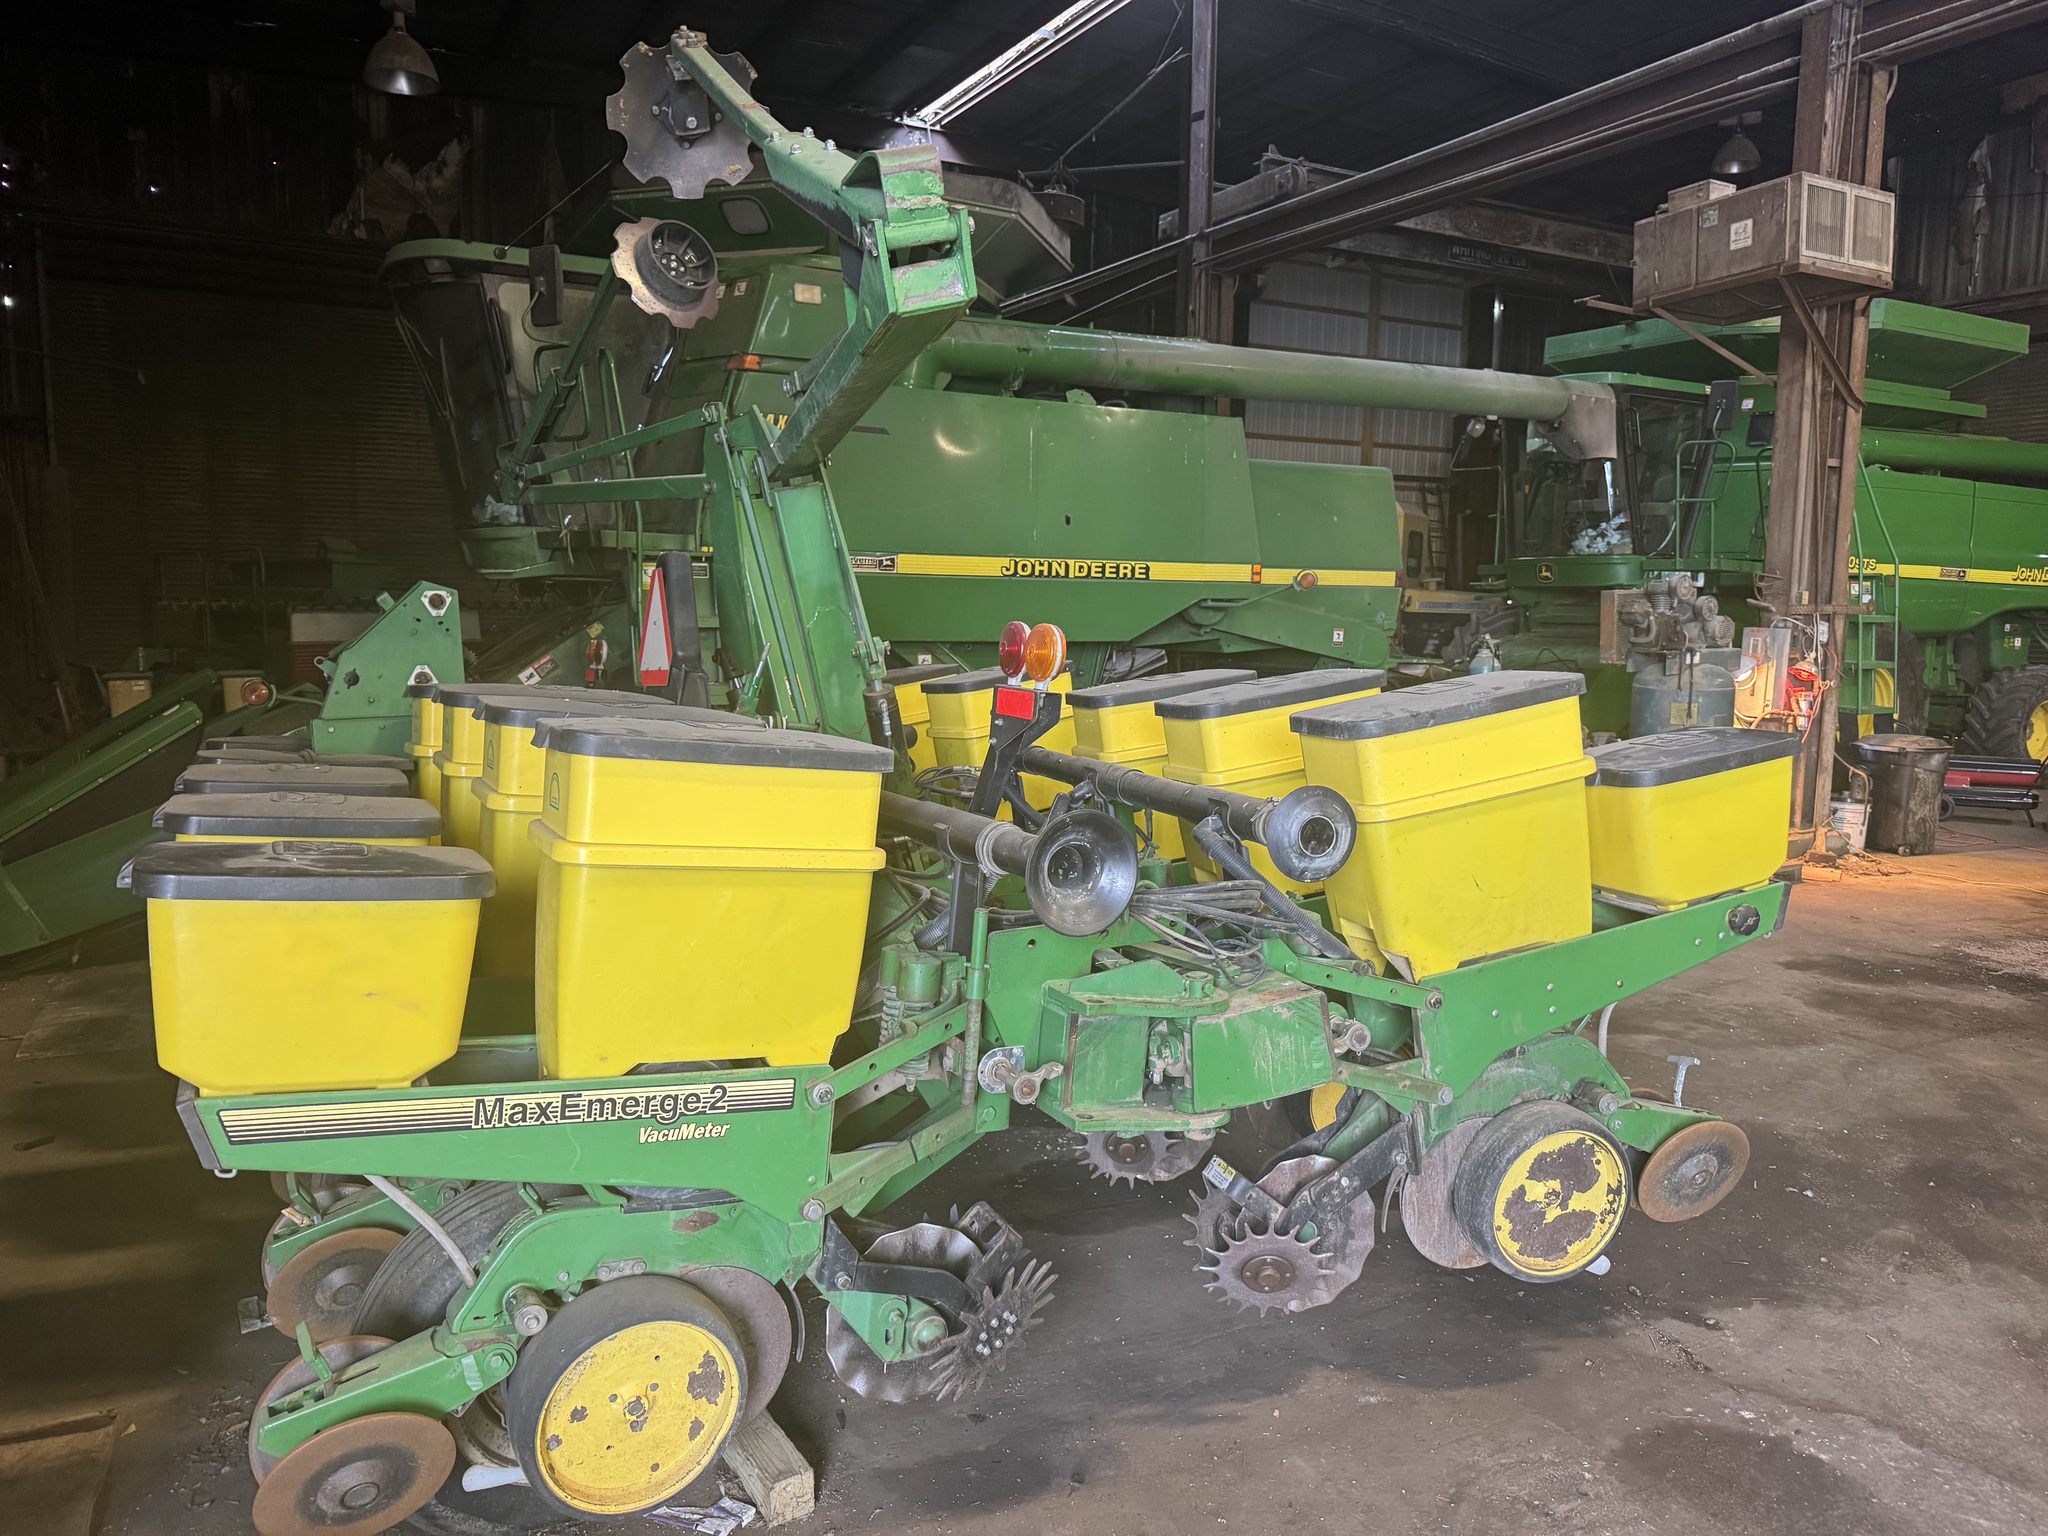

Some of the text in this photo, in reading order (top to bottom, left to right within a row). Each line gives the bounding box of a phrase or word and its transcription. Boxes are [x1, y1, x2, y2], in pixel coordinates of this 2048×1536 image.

[1000, 558, 1150, 580] JOHN DEERE
[2011, 564, 2043, 581] JOHN
[639, 1122, 731, 1145] VacuMeter
